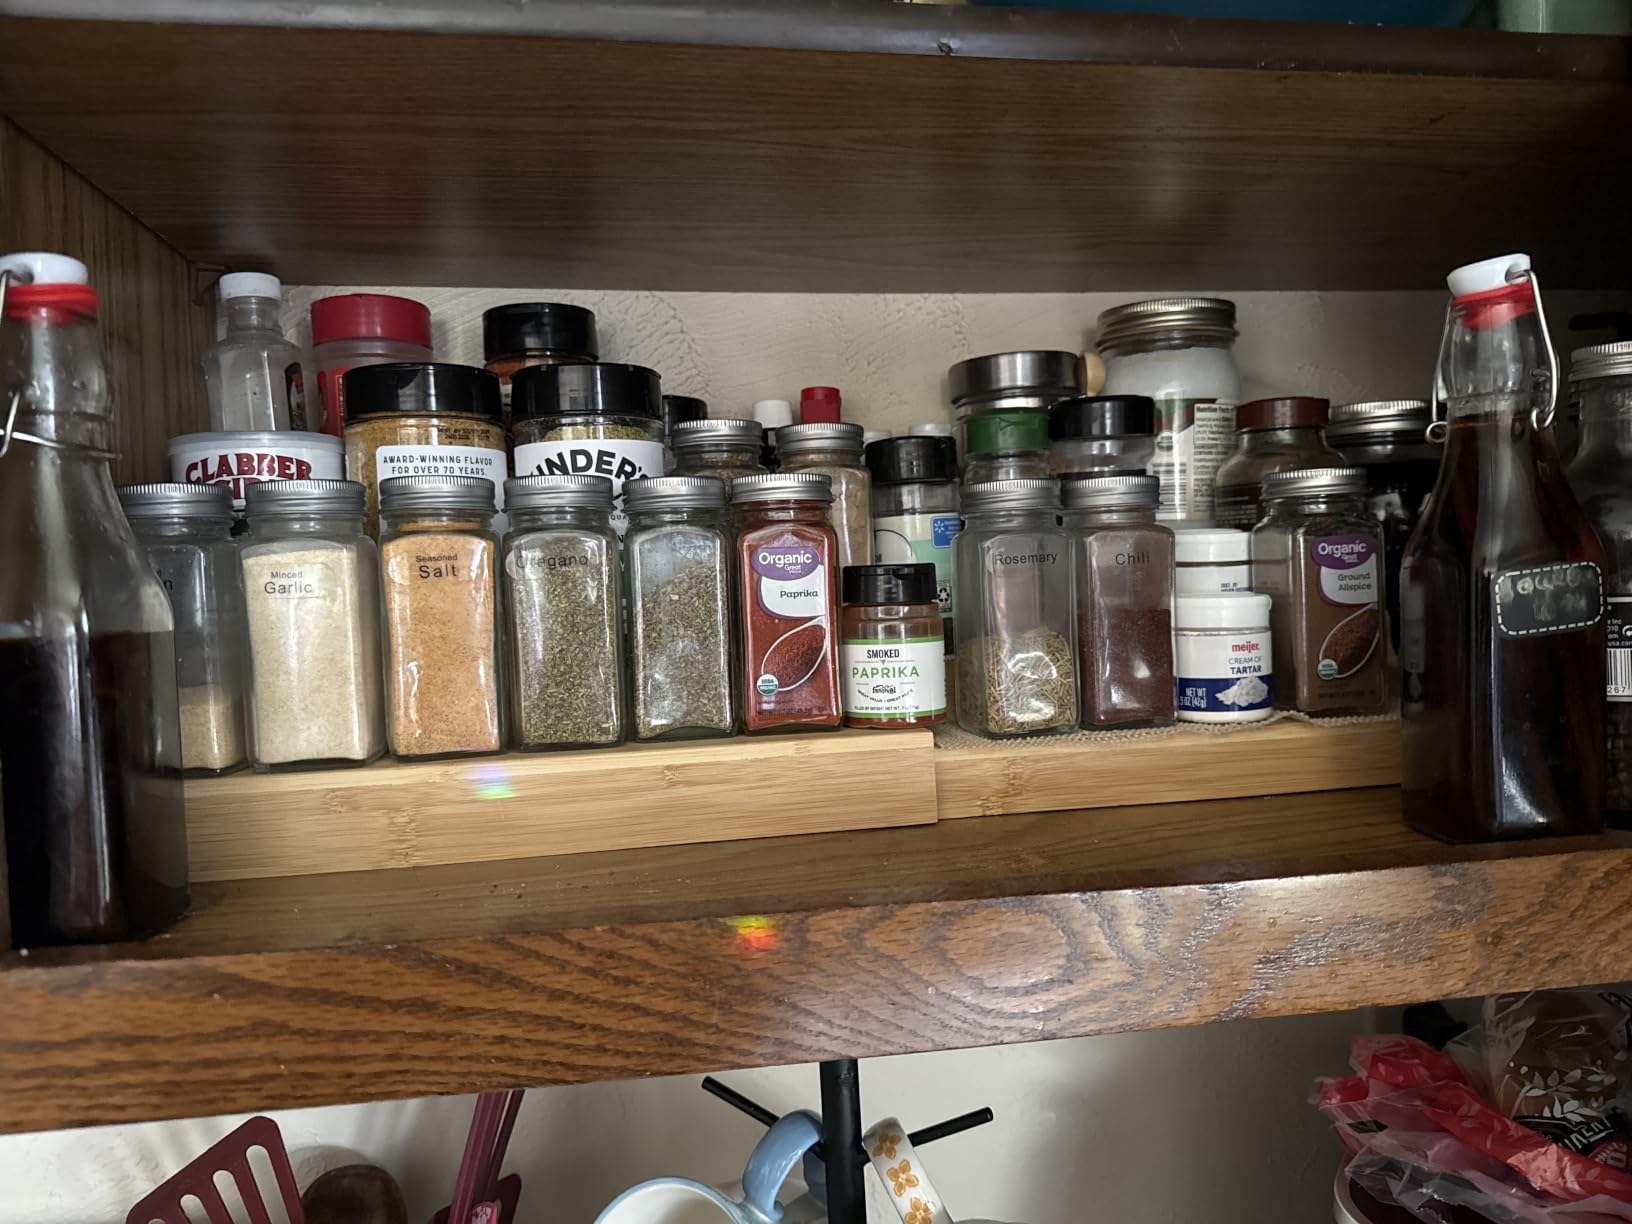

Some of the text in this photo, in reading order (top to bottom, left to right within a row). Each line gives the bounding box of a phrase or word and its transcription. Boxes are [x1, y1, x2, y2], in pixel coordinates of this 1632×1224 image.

[383, 455, 492, 466] AWARD-WINNING FLAVOR
[530, 449, 648, 480] INDER'
[186, 452, 312, 484] CLABBER
[392, 466, 409, 474] FOR
[413, 466, 439, 474] OVER
[443, 466, 454, 474] 70
[1318, 540, 1367, 557] Organic
[415, 554, 458, 563] Seasoned
[759, 551, 812, 568] Organic
[995, 552, 1058, 565] Rosemary
[270, 571, 303, 579] Minced
[419, 563, 457, 579] Salt
[1337, 572, 1371, 582] Ground
[264, 581, 313, 594] Garlic
[1337, 582, 1372, 592] Allspice
[780, 589, 818, 599] Paprika
[1231, 641, 1259, 653] meijer
[867, 649, 900, 659] SMOKED
[1228, 655, 1262, 665] CREAM OF
[852, 665, 920, 679] PAPRIKA
[1230, 665, 1262, 675] TARTAR
[1185, 687, 1206, 697] NET WT
[1184, 696, 1191, 706] OZ
